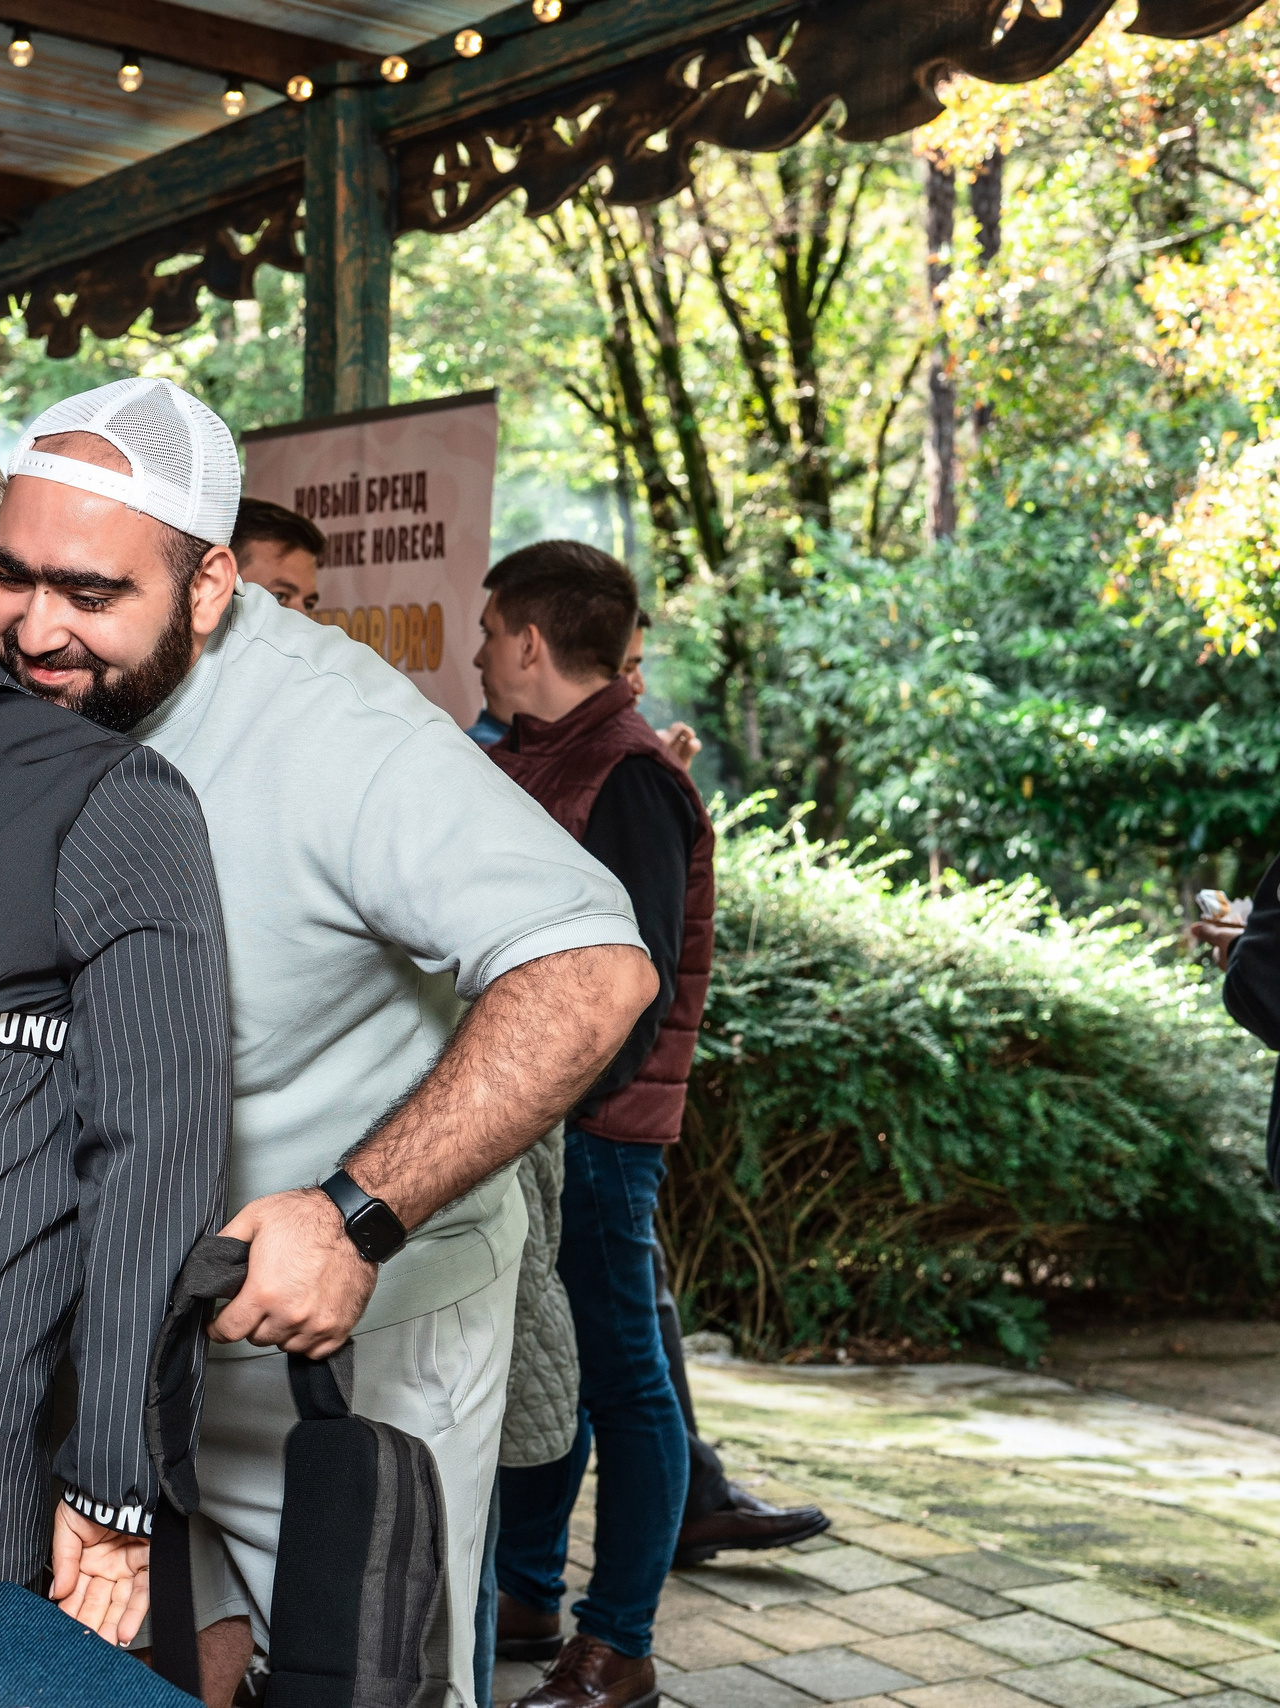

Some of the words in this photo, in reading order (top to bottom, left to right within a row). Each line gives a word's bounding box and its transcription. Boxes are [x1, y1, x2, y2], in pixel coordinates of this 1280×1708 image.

[295, 472, 359, 519] НОВЫЙ
[366, 470, 427, 514] БРЕНД
[316, 530, 365, 569] ЫНКЕ
[372, 521, 445, 564] HORECA
